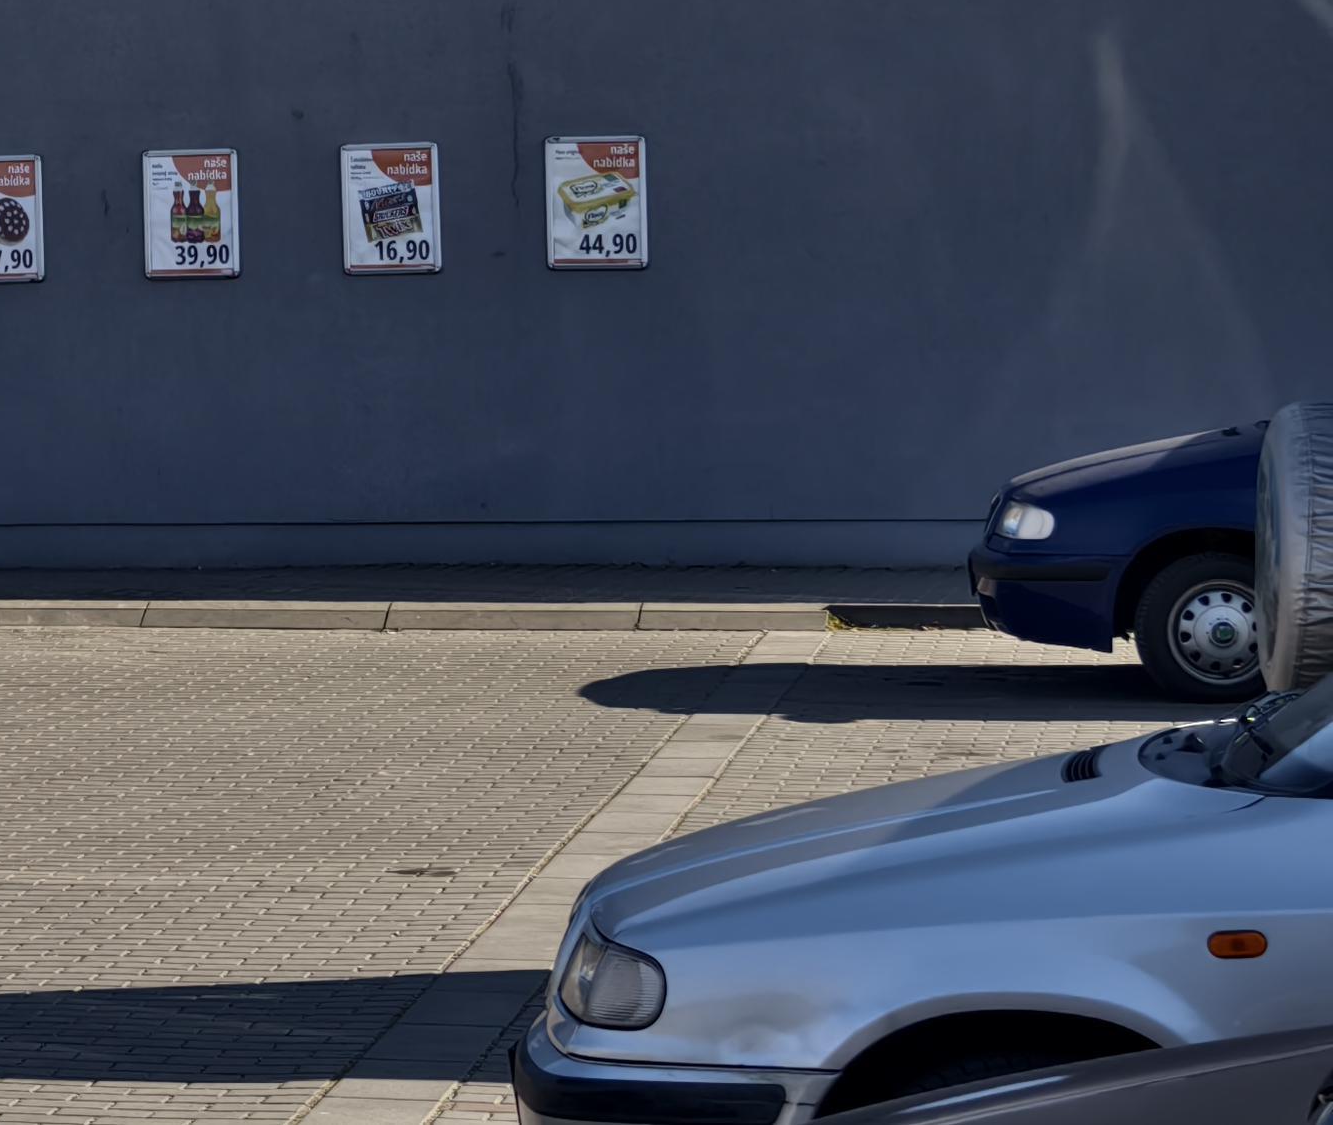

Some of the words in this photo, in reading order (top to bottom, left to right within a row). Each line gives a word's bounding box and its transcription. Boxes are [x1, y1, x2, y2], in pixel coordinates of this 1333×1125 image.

[610, 144, 635, 155] naše
[203, 156, 227, 168] naše
[403, 150, 428, 162] naše
[593, 156, 635, 168] nabídka
[8, 163, 30, 174] naše
[387, 163, 428, 175] nabídka
[187, 169, 227, 181] nabídka
[579, 232, 637, 257] 44,90
[175, 244, 230, 268] 39,90
[374, 239, 430, 264] 16,90
